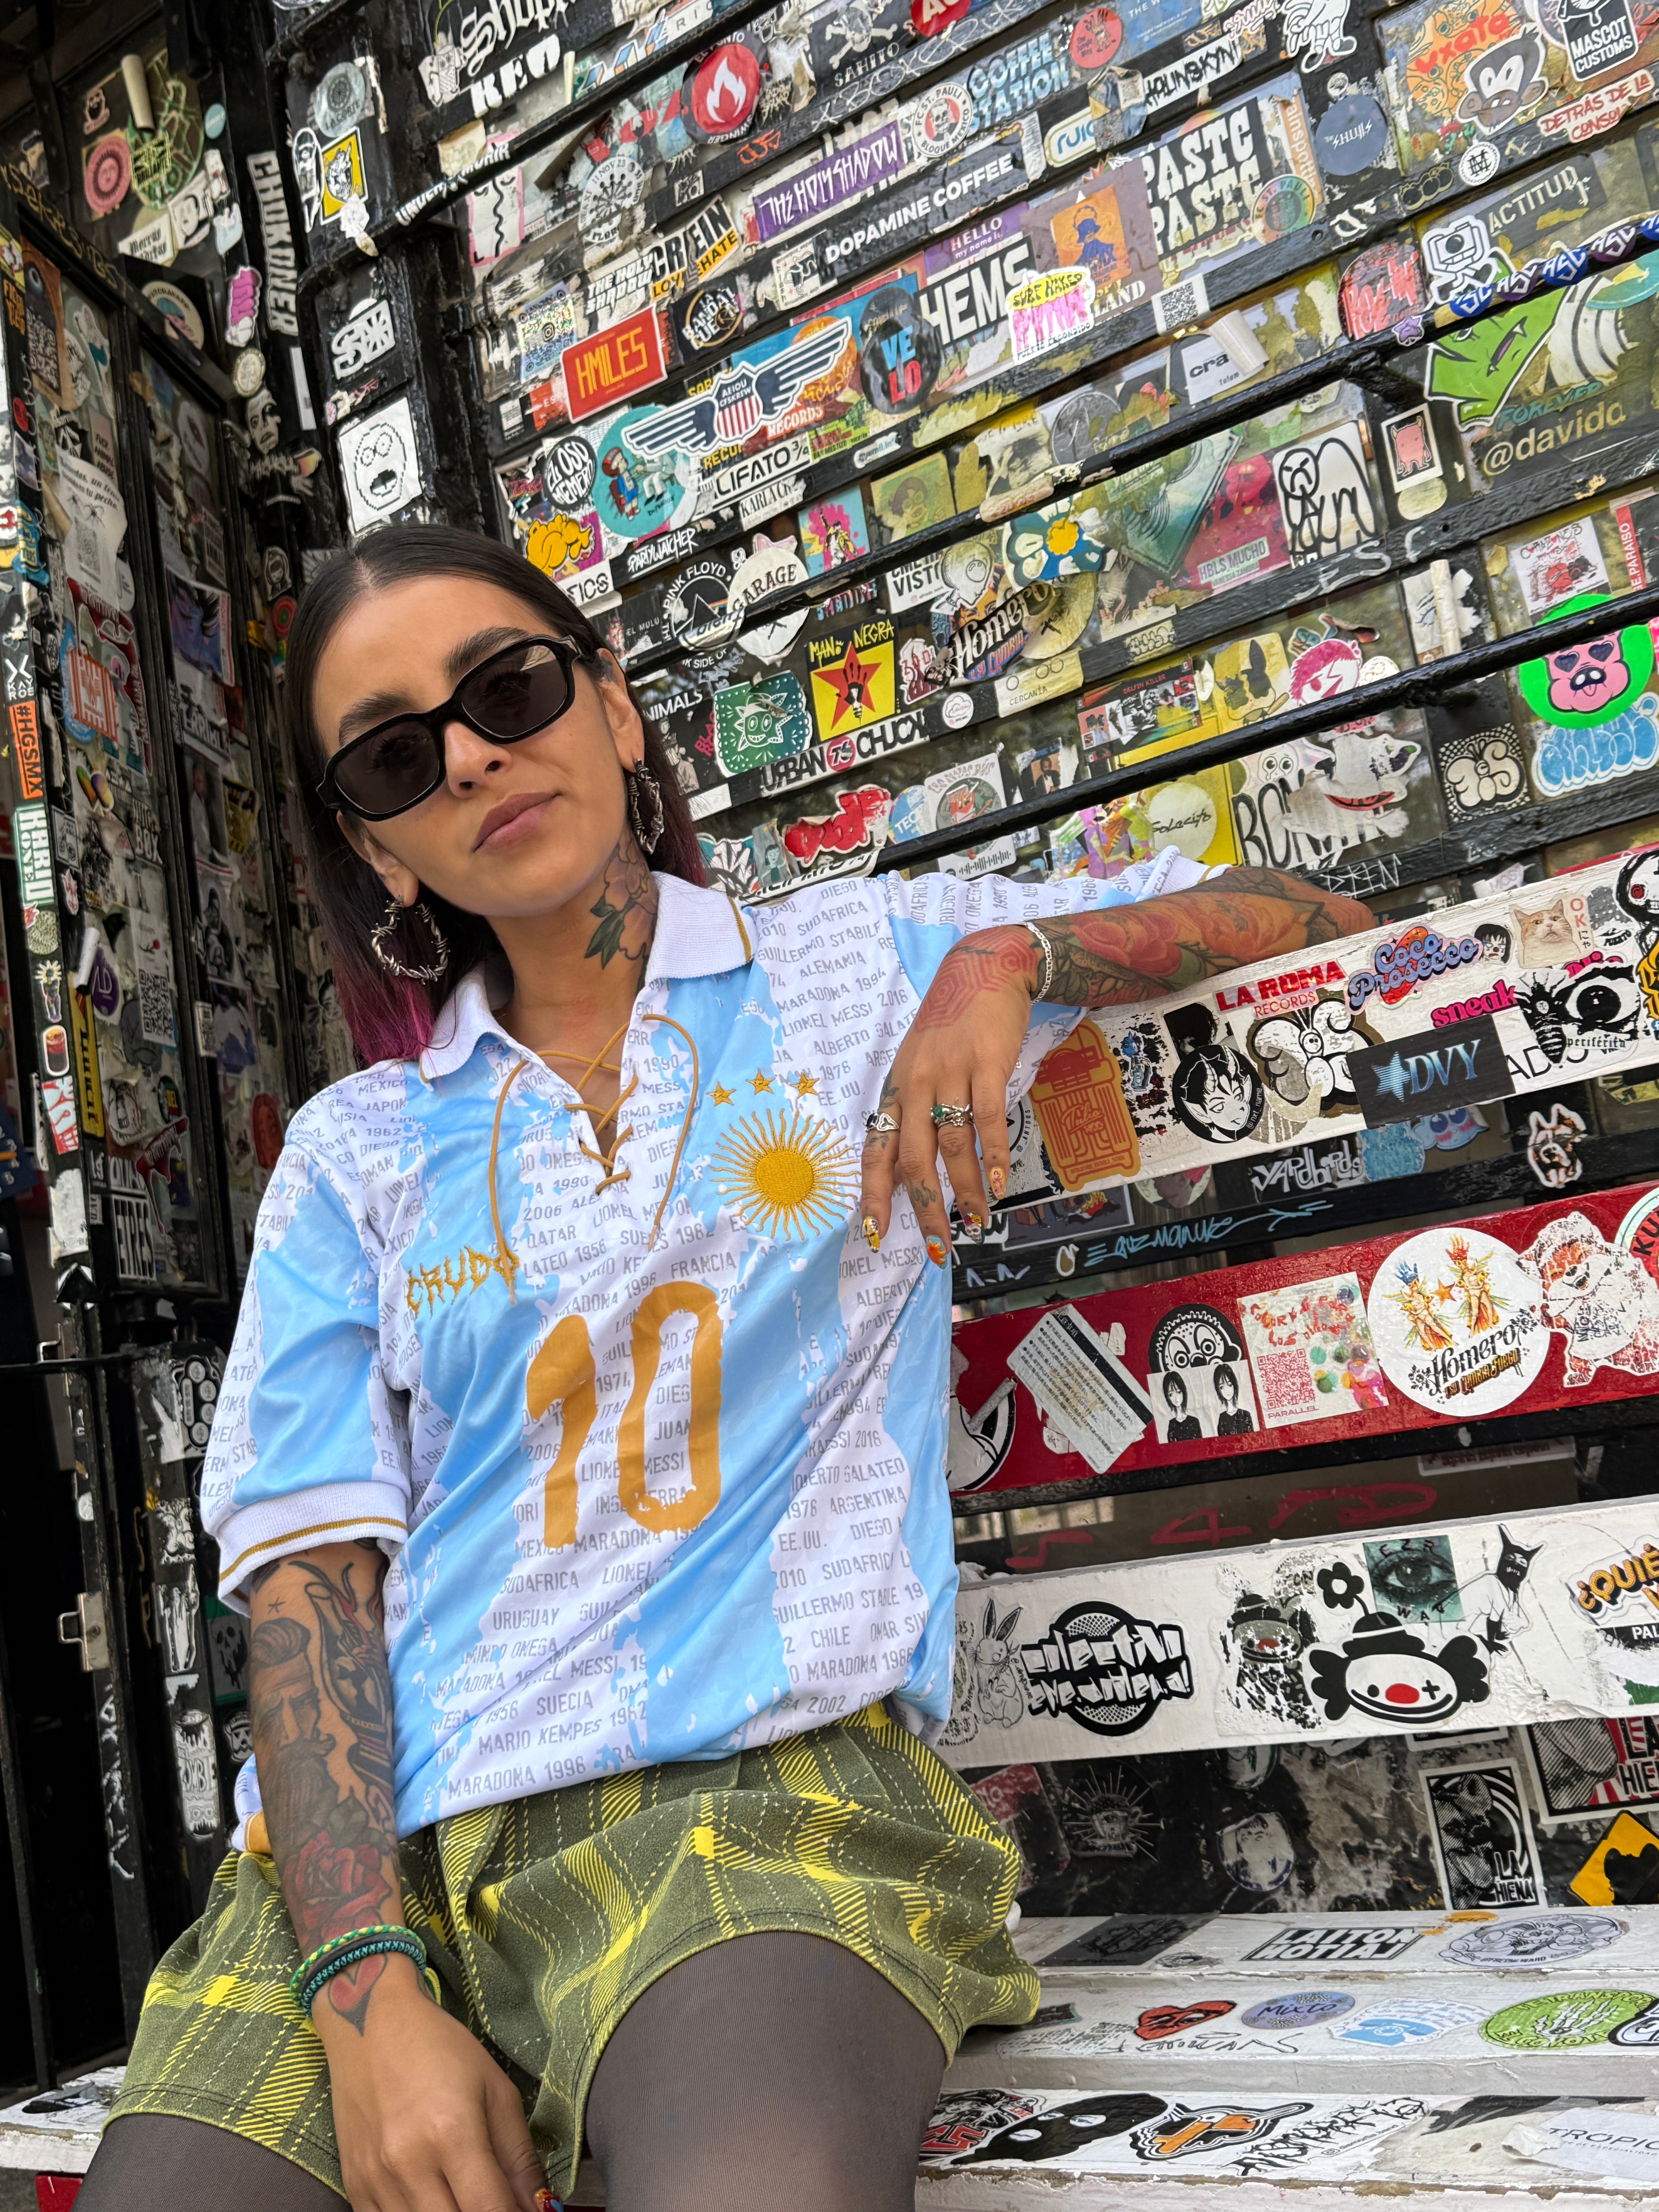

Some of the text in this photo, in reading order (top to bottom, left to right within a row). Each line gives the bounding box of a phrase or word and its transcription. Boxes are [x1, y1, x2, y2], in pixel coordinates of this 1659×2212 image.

[1571, 16, 1628, 59] MASCOT
[968, 31, 1052, 99] COFFEE
[1576, 36, 1633, 73] CUSTOMS
[936, 84, 963, 101] PAULI
[969, 57, 1071, 132] STATION
[1605, 83, 1629, 105] DE
[1634, 72, 1652, 92] LA
[833, 131, 899, 193] SHADOW
[826, 153, 1014, 264] DOPAMINE COFFEE
[247, 150, 300, 336] CHOKONER
[1013, 283, 1045, 307] SURF
[1044, 272, 1084, 299] NAKED
[722, 378, 748, 397] AEIOU
[559, 439, 589, 474] OSO
[1229, 540, 1268, 568] MUCHO
[663, 561, 727, 609] PINK FLOYD
[853, 620, 895, 646] NEGRA
[693, 656, 715, 669] SIDE
[8, 687, 35, 700] ROE
[16, 705, 43, 798] #HGSMX
[798, 901, 868, 937] SUDAFRICA
[800, 951, 867, 980] ALEMANIA
[1374, 933, 1443, 976] Coco
[1215, 961, 1347, 1013] LA ROMA
[1347, 938, 1480, 1013] Prosecco
[776, 982, 852, 1013] MARADONA
[1254, 991, 1317, 1018] RECORDS
[781, 1001, 873, 1037] LIONEL MESSI
[814, 1029, 870, 1055] ALBERTO
[1404, 1039, 1481, 1095] DVY
[526, 1224, 577, 1249] QATAR
[670, 1251, 737, 1278] FRANCIA
[526, 1281, 722, 1549] 10
[843, 1457, 906, 1484] GALATEO
[830, 1486, 908, 1516] ARGENTINA
[850, 1519, 893, 1541] DIEGO
[499, 1570, 580, 1595] SUDAFRICA
[492, 1608, 560, 1630] URUGUAY
[810, 1624, 898, 1649] CHILE OMAR
[807, 1653, 878, 1681] MARADONA
[536, 1690, 594, 1716] SUECIA
[478, 1719, 602, 1755] MARIO KEMPES
[447, 1766, 537, 1800] MARADONA
[1493, 1878, 1535, 1903] HIENA
